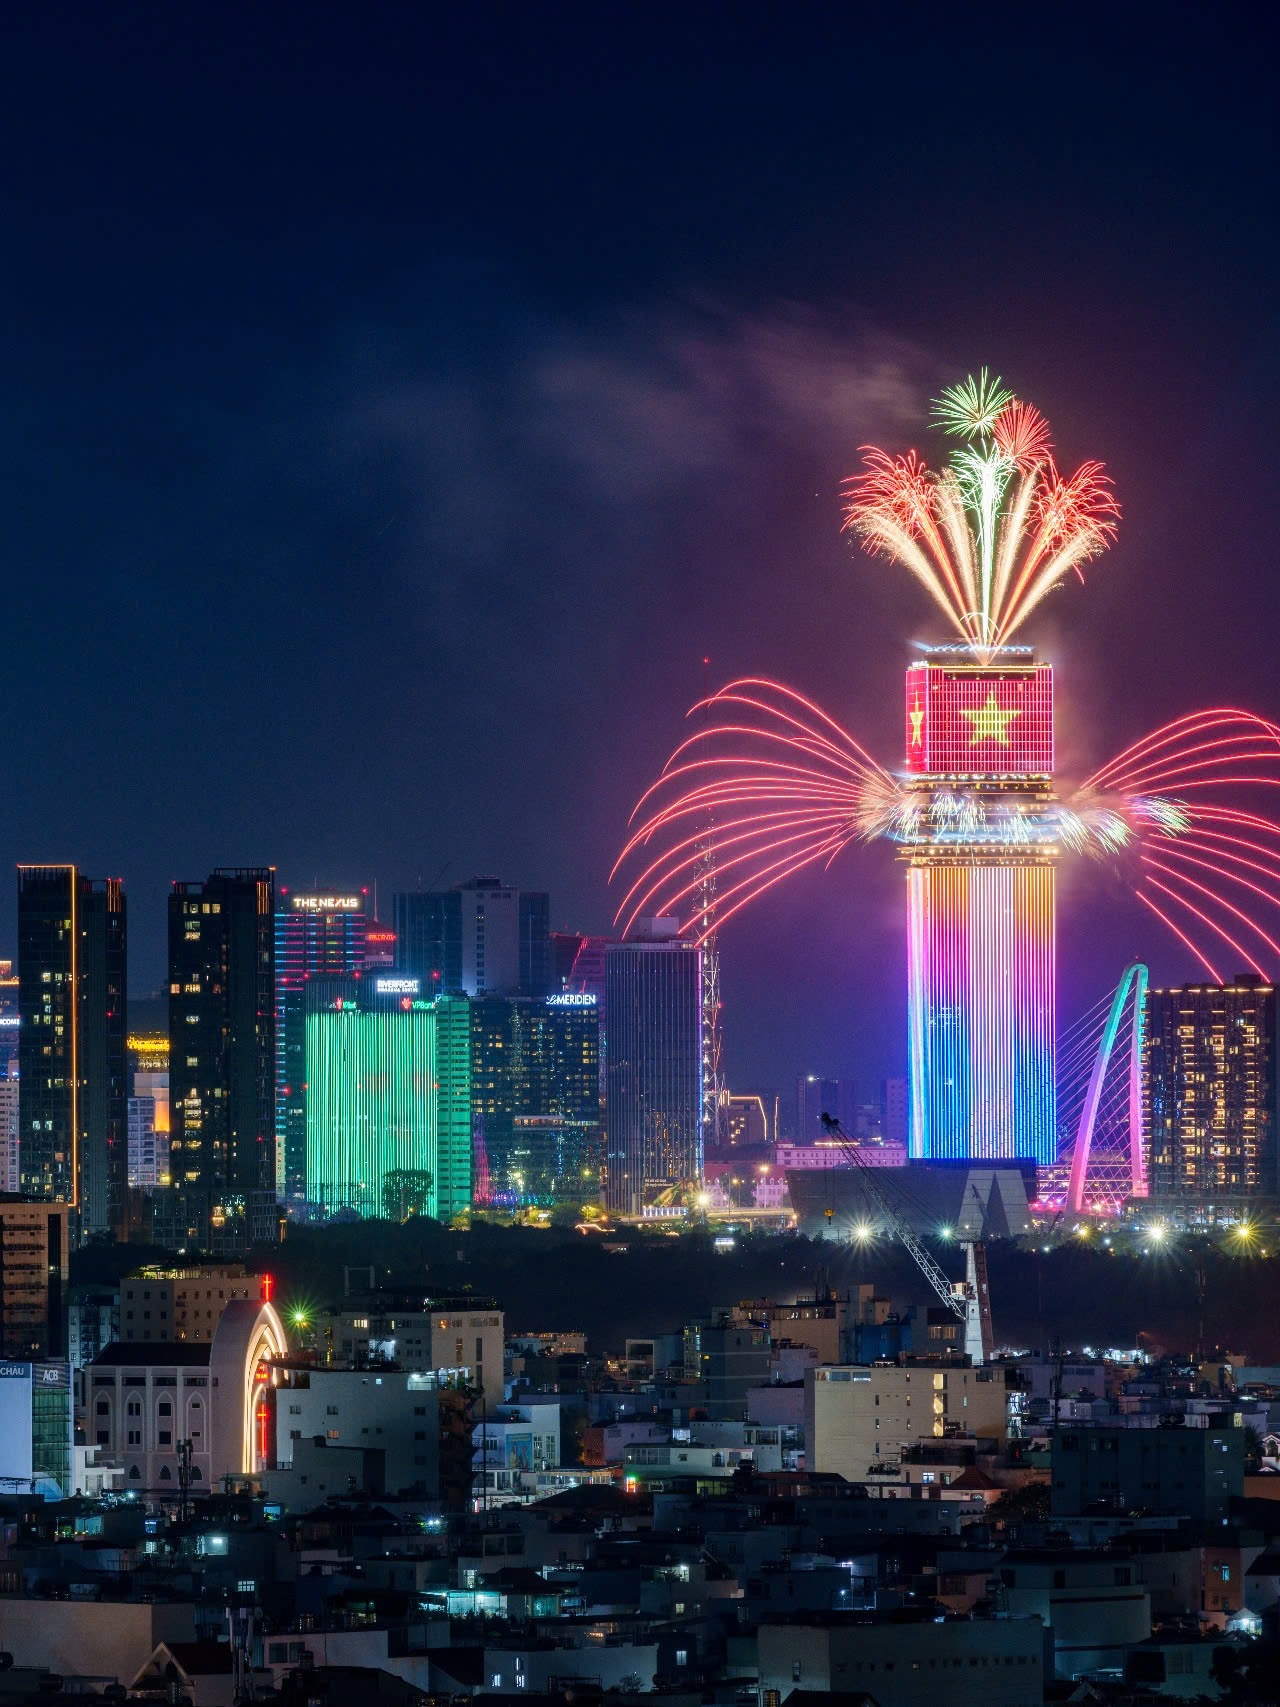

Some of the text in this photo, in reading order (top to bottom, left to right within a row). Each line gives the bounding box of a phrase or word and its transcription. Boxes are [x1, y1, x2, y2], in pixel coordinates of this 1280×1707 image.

[294, 898, 358, 907] THE NEXUS
[412, 1001, 436, 1009] VPBank
[557, 994, 596, 1005] MERIDIEN
[0, 1365, 25, 1376] CHÂU
[42, 1369, 59, 1382] ACB
